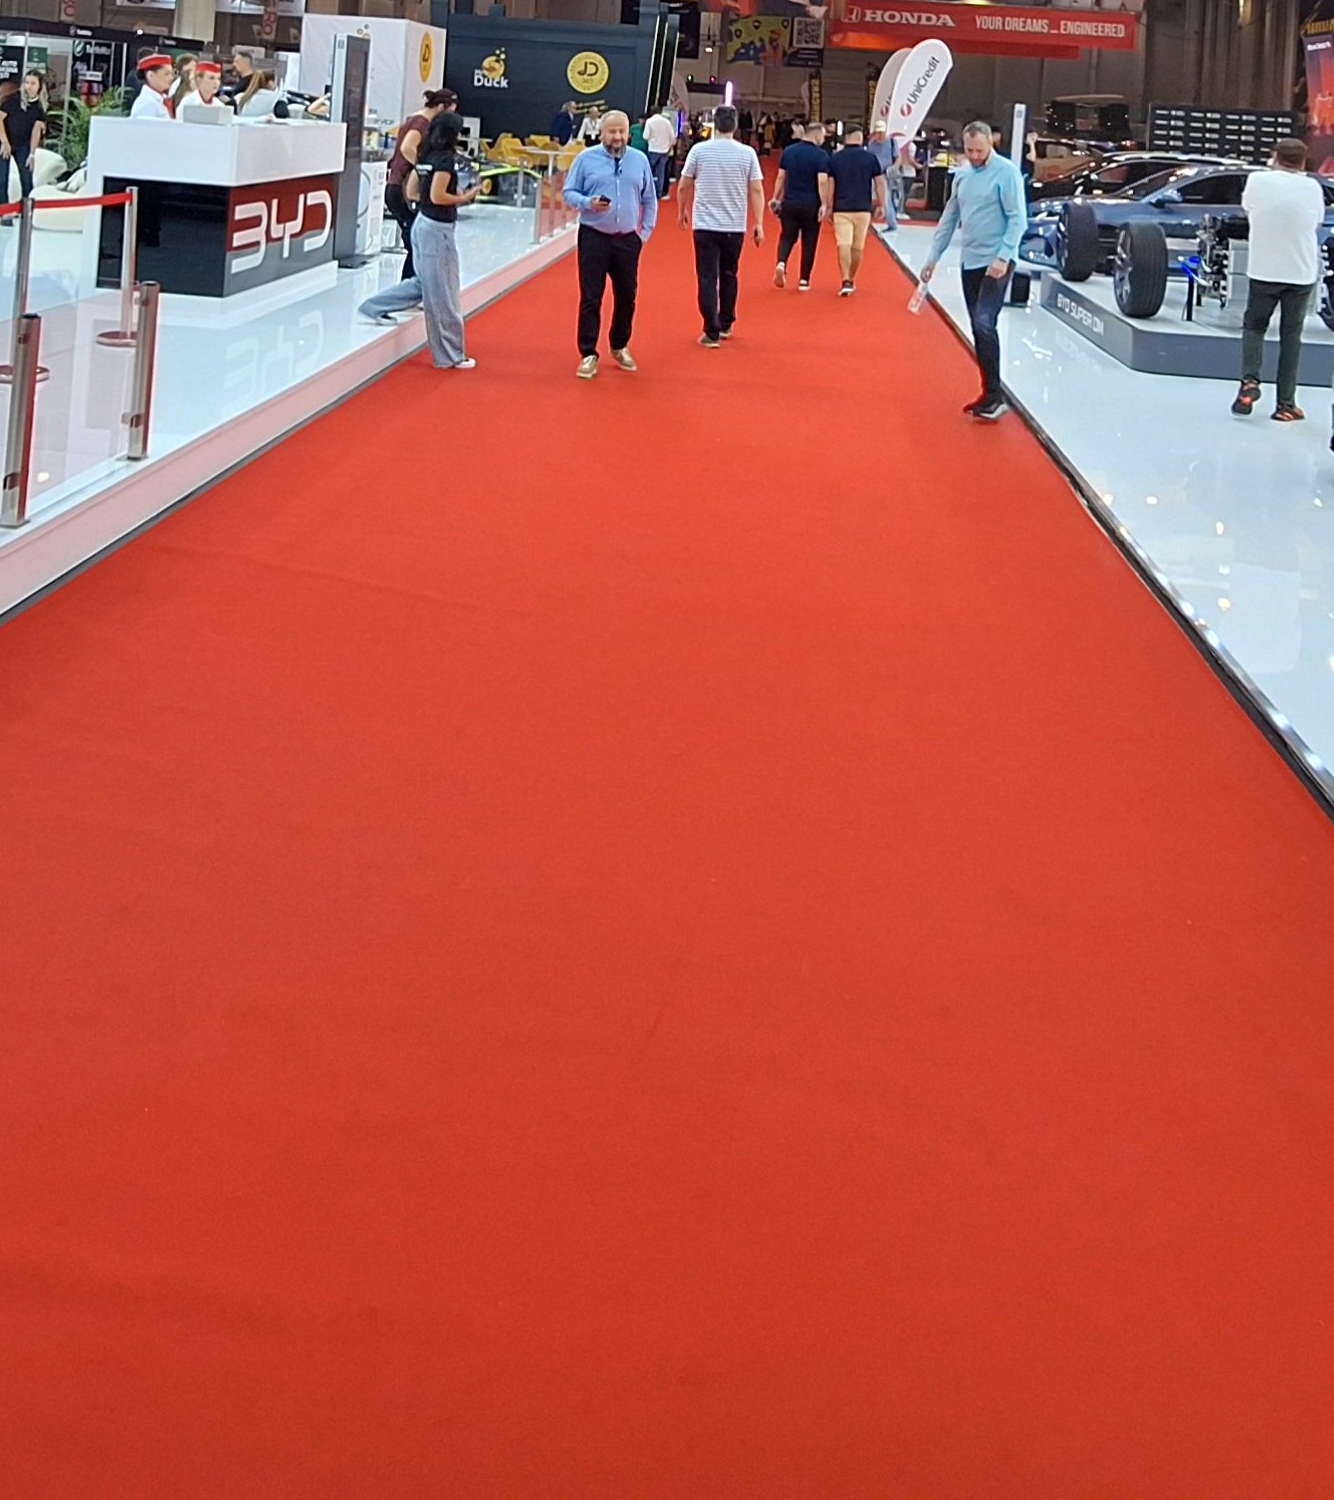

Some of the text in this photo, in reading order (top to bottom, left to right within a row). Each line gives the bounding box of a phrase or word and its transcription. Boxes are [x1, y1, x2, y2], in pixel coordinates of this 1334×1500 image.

[864, 9, 955, 27] HONDA
[975, 15, 1003, 30] YOUR
[1004, 15, 1049, 33] DREAMS
[1060, 20, 1126, 38] ENGINEERED
[473, 75, 509, 89] Duck
[907, 56, 940, 104] UniCredit
[231, 189, 333, 275] BYD
